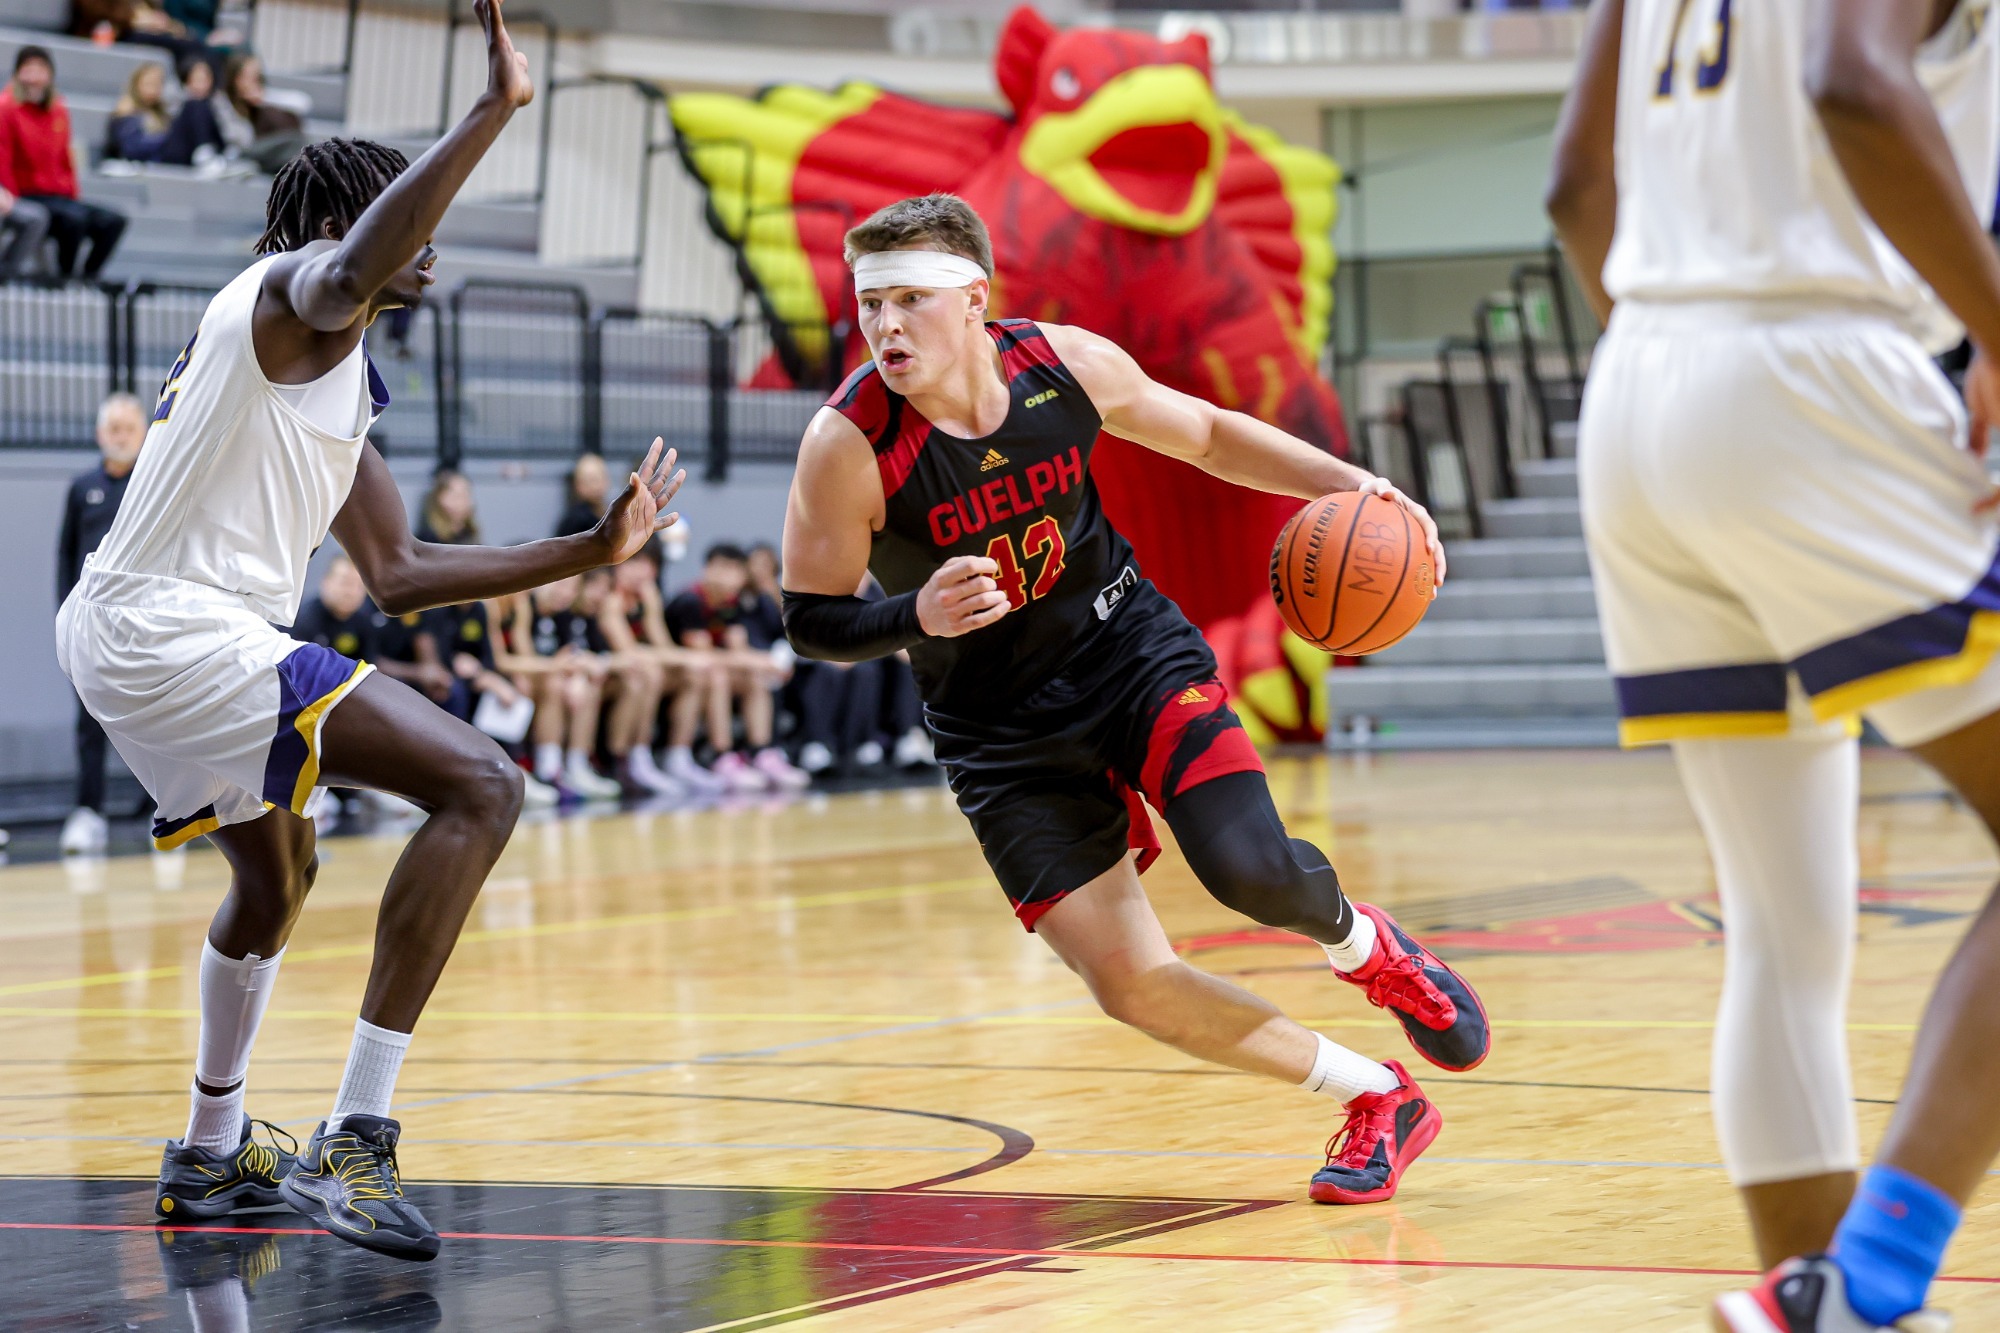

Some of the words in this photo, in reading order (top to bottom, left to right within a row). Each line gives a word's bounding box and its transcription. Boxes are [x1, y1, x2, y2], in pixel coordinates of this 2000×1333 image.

[1024, 388, 1059, 409] OUA
[927, 445, 1082, 547] GUELPH
[980, 457, 1010, 472] adidas
[979, 514, 1066, 613] 42
[1304, 501, 1342, 598] EVOLUTION
[1347, 521, 1397, 595] MBB
